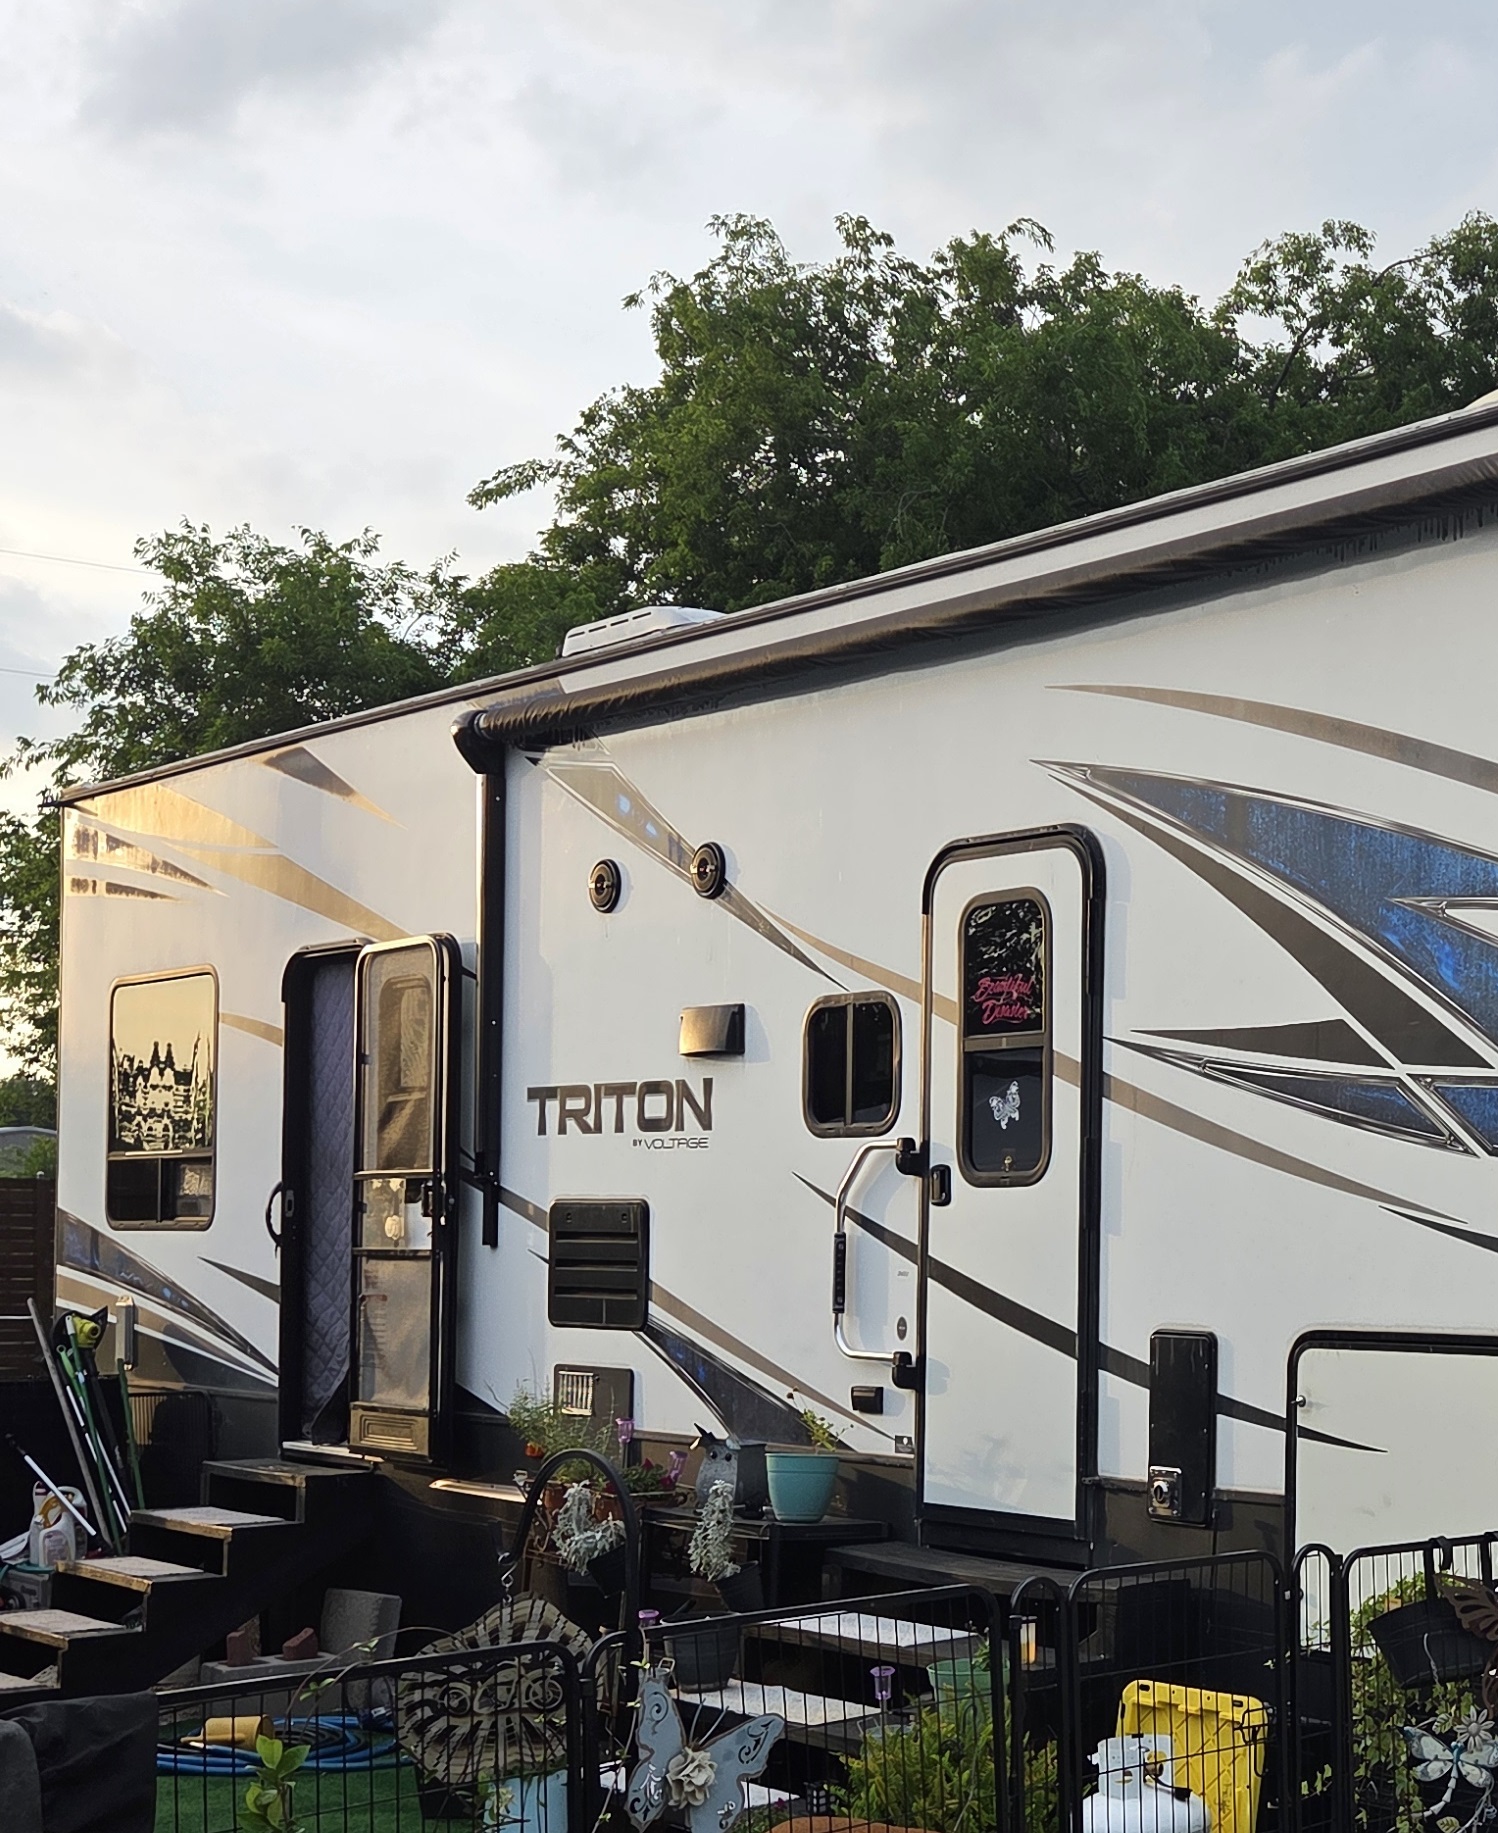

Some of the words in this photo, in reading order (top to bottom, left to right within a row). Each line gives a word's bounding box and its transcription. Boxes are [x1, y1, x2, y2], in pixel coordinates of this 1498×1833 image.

[971, 973, 1035, 1002] Beautiful
[527, 1077, 713, 1136] TRITON
[632, 1139, 642, 1147] BY
[644, 1137, 709, 1149] VOLTAGE
